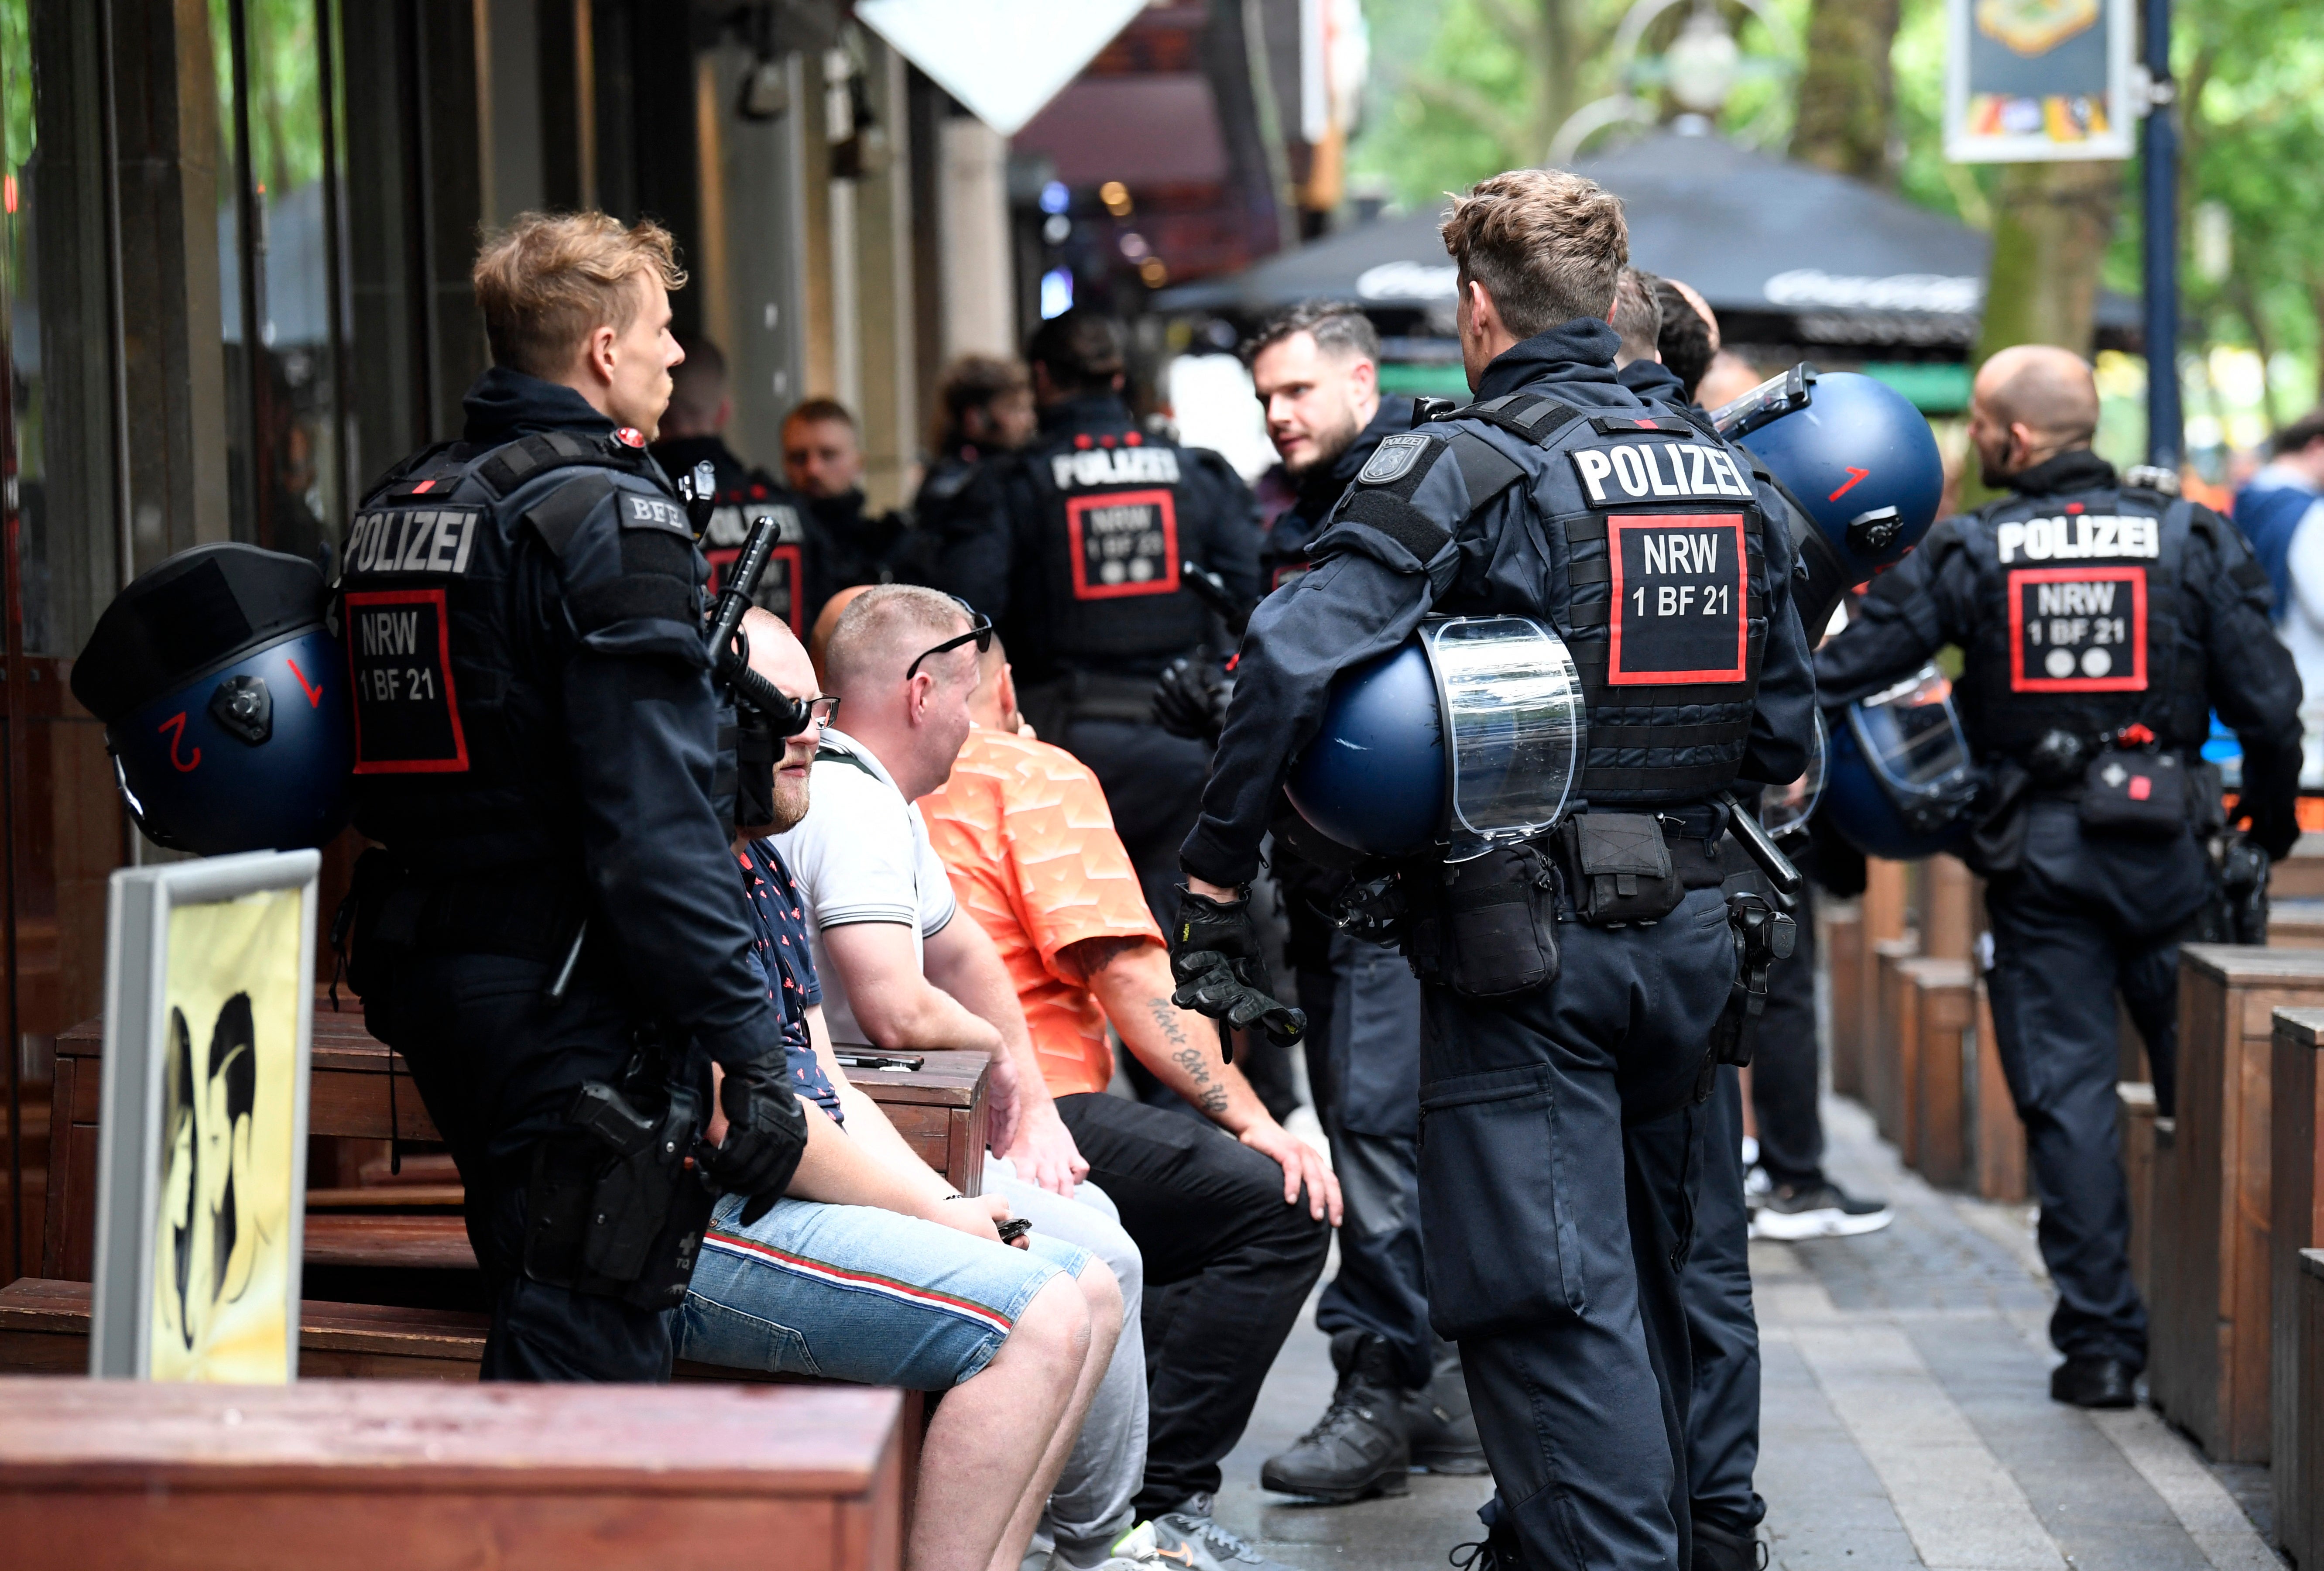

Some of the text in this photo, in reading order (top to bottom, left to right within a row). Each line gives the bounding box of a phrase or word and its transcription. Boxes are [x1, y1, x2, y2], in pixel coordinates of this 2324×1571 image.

[1383, 437, 1421, 446] POLIZEI
[1574, 443, 1753, 501] POLIZEI
[630, 497, 683, 529] BFE
[343, 511, 478, 574] POLIZEI
[1644, 534, 1717, 574] NRW
[1998, 515, 2159, 564] POLIZEI
[1632, 585, 1728, 616] 1 BF 21
[2038, 581, 2115, 617] NRW
[361, 611, 418, 656] NRW
[2027, 619, 2042, 646] 1
[2093, 616, 2125, 645] 21
[360, 667, 434, 702] 1 BF 21
